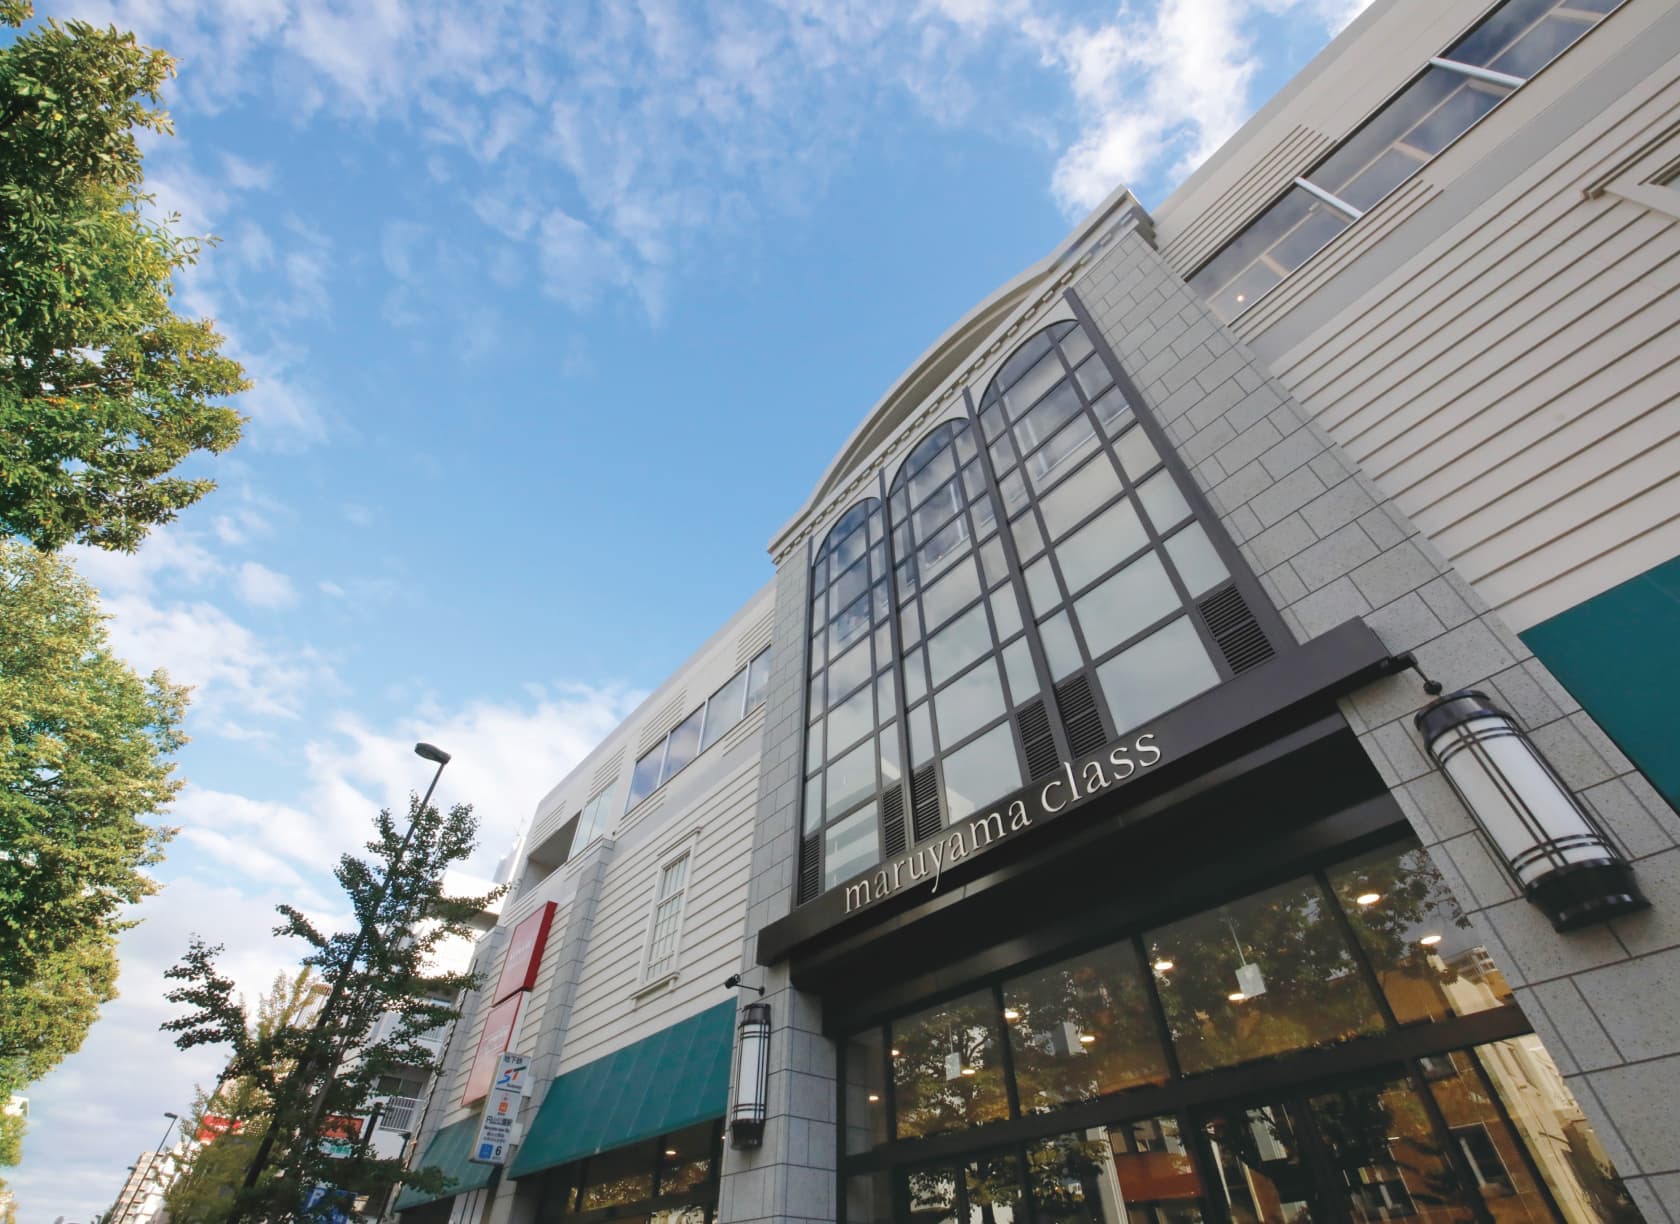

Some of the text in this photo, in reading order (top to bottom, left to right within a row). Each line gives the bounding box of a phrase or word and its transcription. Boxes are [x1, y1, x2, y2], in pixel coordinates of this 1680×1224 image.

[843, 733, 1162, 914] maruyama class
[495, 1146, 502, 1156] 6
[307, 1188, 325, 1209] P
